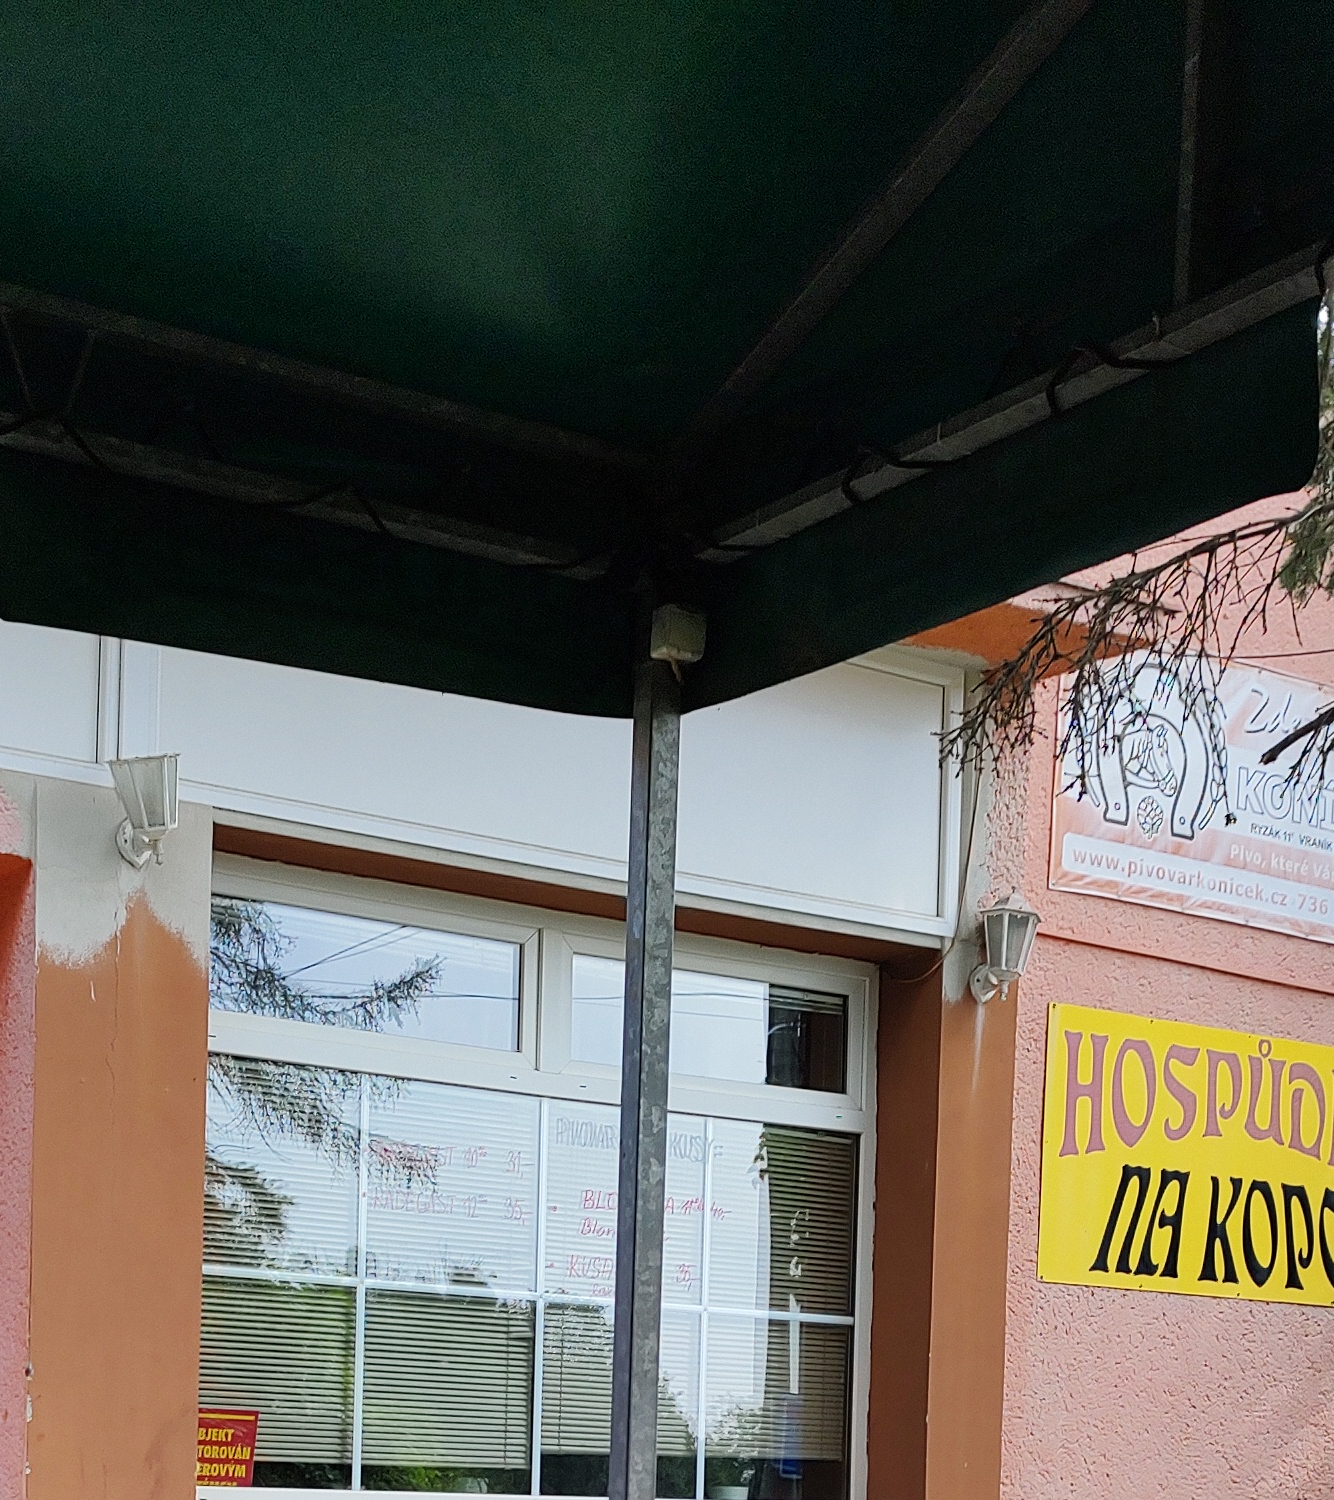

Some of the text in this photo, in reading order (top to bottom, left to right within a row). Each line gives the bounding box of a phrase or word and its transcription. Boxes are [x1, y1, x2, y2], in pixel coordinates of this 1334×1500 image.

[1271, 852, 1309, 876] které
[1073, 846, 1288, 907] www.pivovarkonicek.cz
[1297, 893, 1328, 915] 736
[1089, 1163, 1191, 1279] NA
[198, 1427, 234, 1442] BJEKT
[197, 1442, 252, 1460] TOROVÁN
[196, 1460, 247, 1478] EROVÝM
